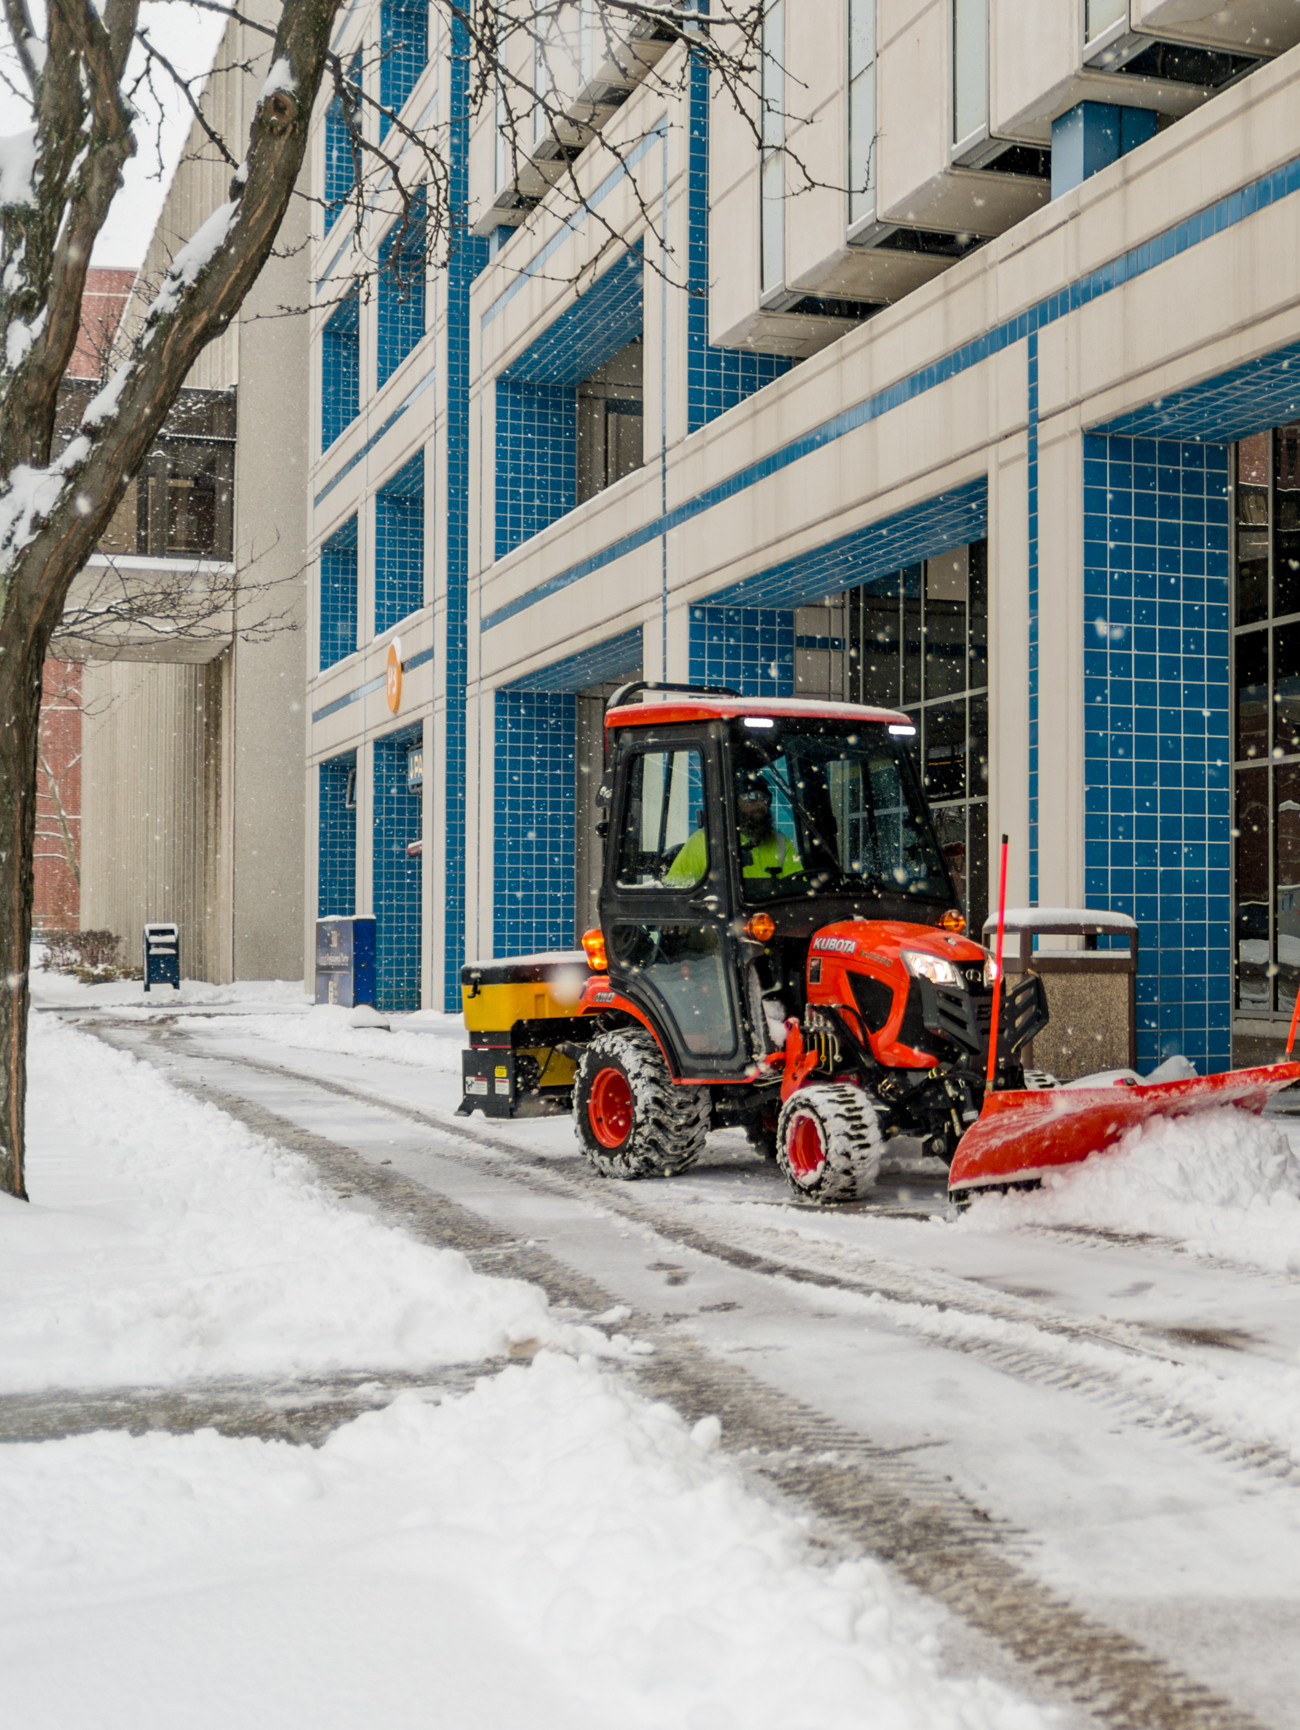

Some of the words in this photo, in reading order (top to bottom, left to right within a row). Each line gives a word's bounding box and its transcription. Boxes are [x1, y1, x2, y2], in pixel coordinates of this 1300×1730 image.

[388, 664, 397, 695] P3
[812, 937, 856, 954] KUBOTA
[593, 991, 616, 1003] 4WD
